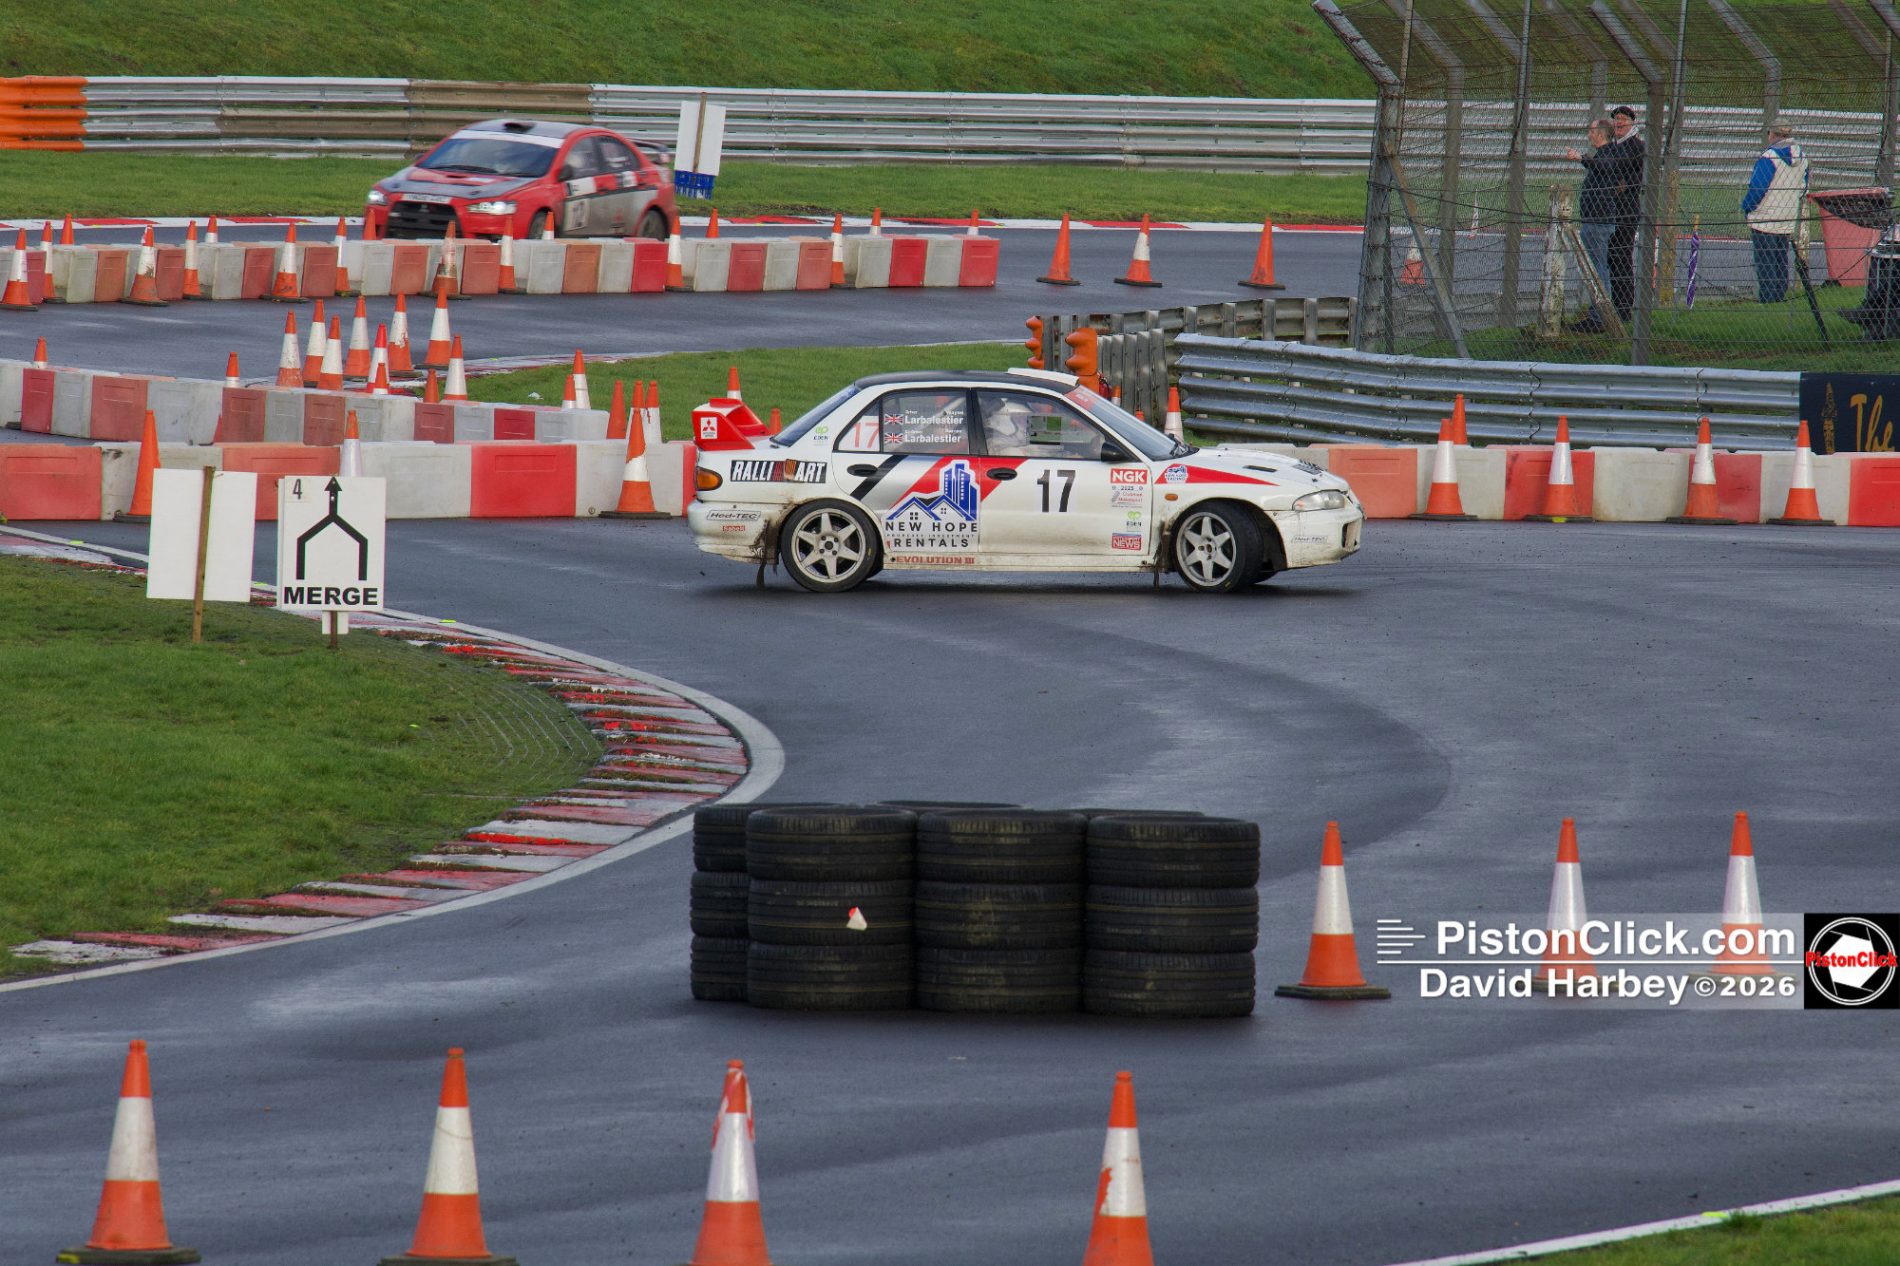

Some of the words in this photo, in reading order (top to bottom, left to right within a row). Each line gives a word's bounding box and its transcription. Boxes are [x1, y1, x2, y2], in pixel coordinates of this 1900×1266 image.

[904, 414, 963, 425] Larbalestier
[1850, 393, 1895, 452] The
[853, 422, 880, 448] 17
[904, 433, 962, 443] Larbalestier
[732, 461, 774, 480] RALLI
[1112, 470, 1146, 482] NGK
[293, 479, 302, 499] 4
[1036, 469, 1076, 512] 17
[885, 522, 921, 532] NEW
[932, 522, 977, 532] HOPE
[894, 538, 969, 548] RENTALS
[896, 556, 962, 564] EVOLUTION
[284, 587, 378, 605] MERGE
